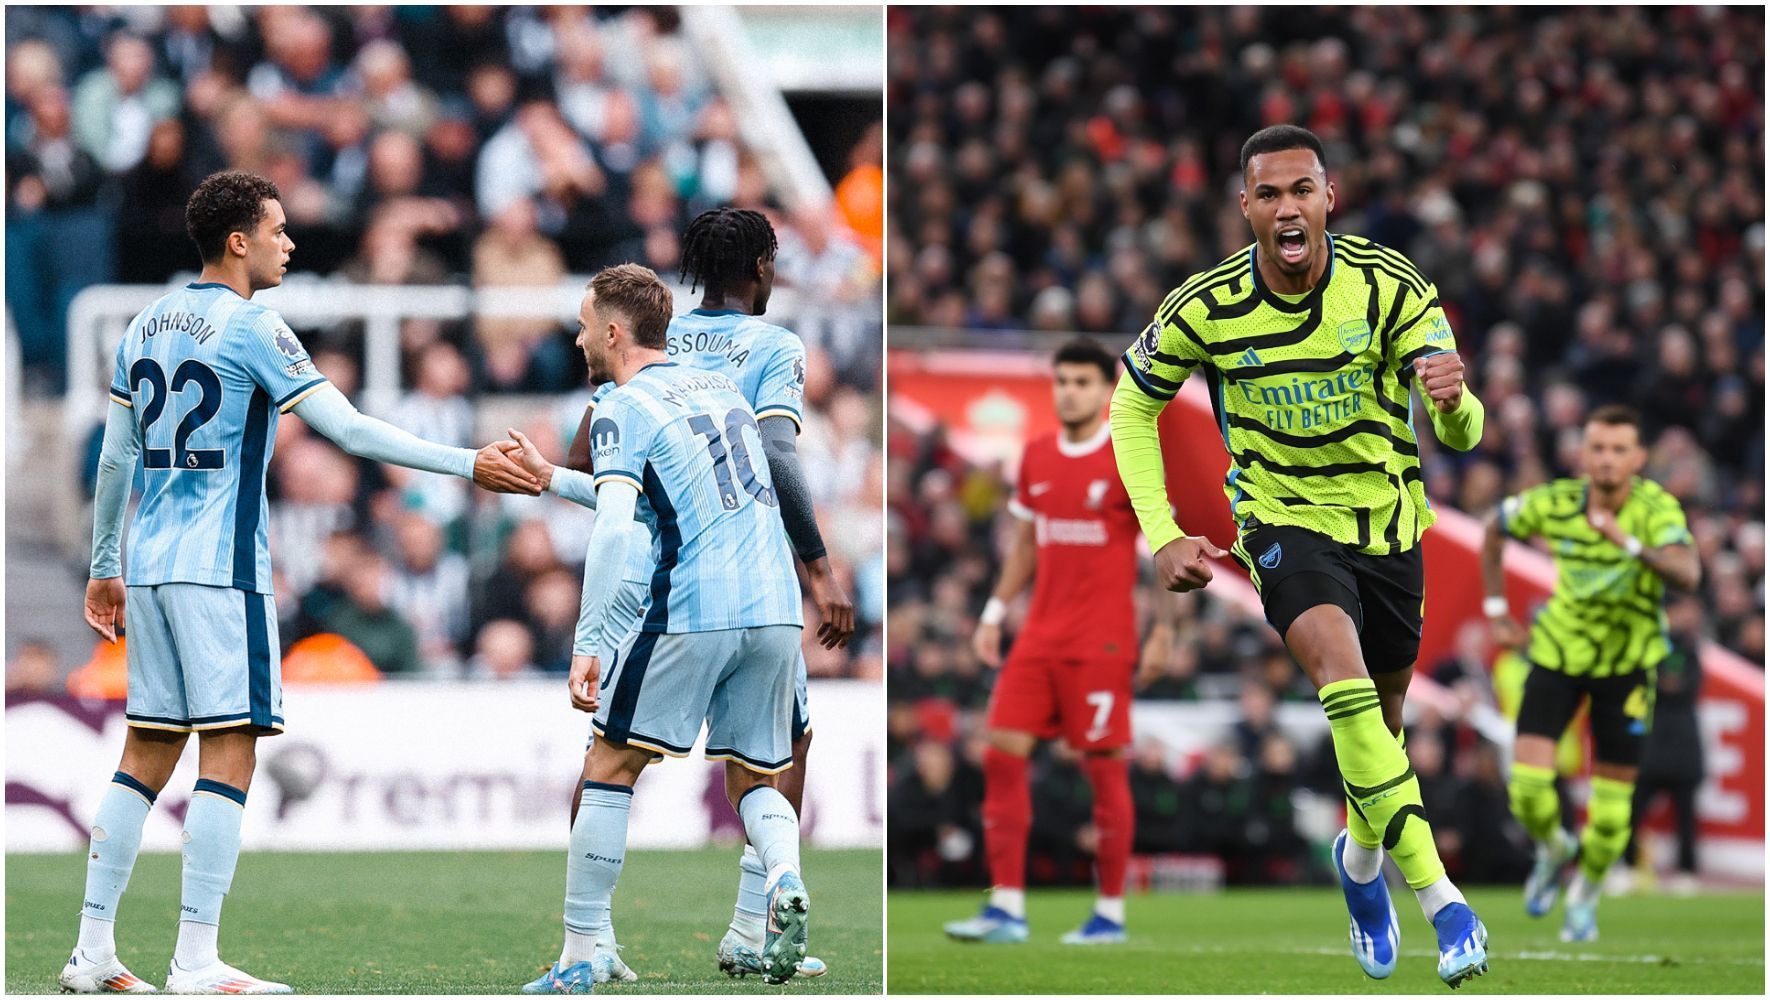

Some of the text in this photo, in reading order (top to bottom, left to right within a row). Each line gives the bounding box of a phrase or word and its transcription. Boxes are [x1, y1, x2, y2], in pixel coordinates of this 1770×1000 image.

[141, 311, 216, 345] JOHNSON
[666, 332, 750, 368] SSOUMA
[663, 374, 739, 407] MADDISO
[1237, 363, 1374, 405] Emirates
[129, 357, 225, 471] 22
[1266, 392, 1363, 430] FLY BETTER
[687, 408, 778, 511] 10
[1086, 691, 1115, 741] 7
[1361, 788, 1399, 810] AFC
[84, 900, 105, 911] purs
